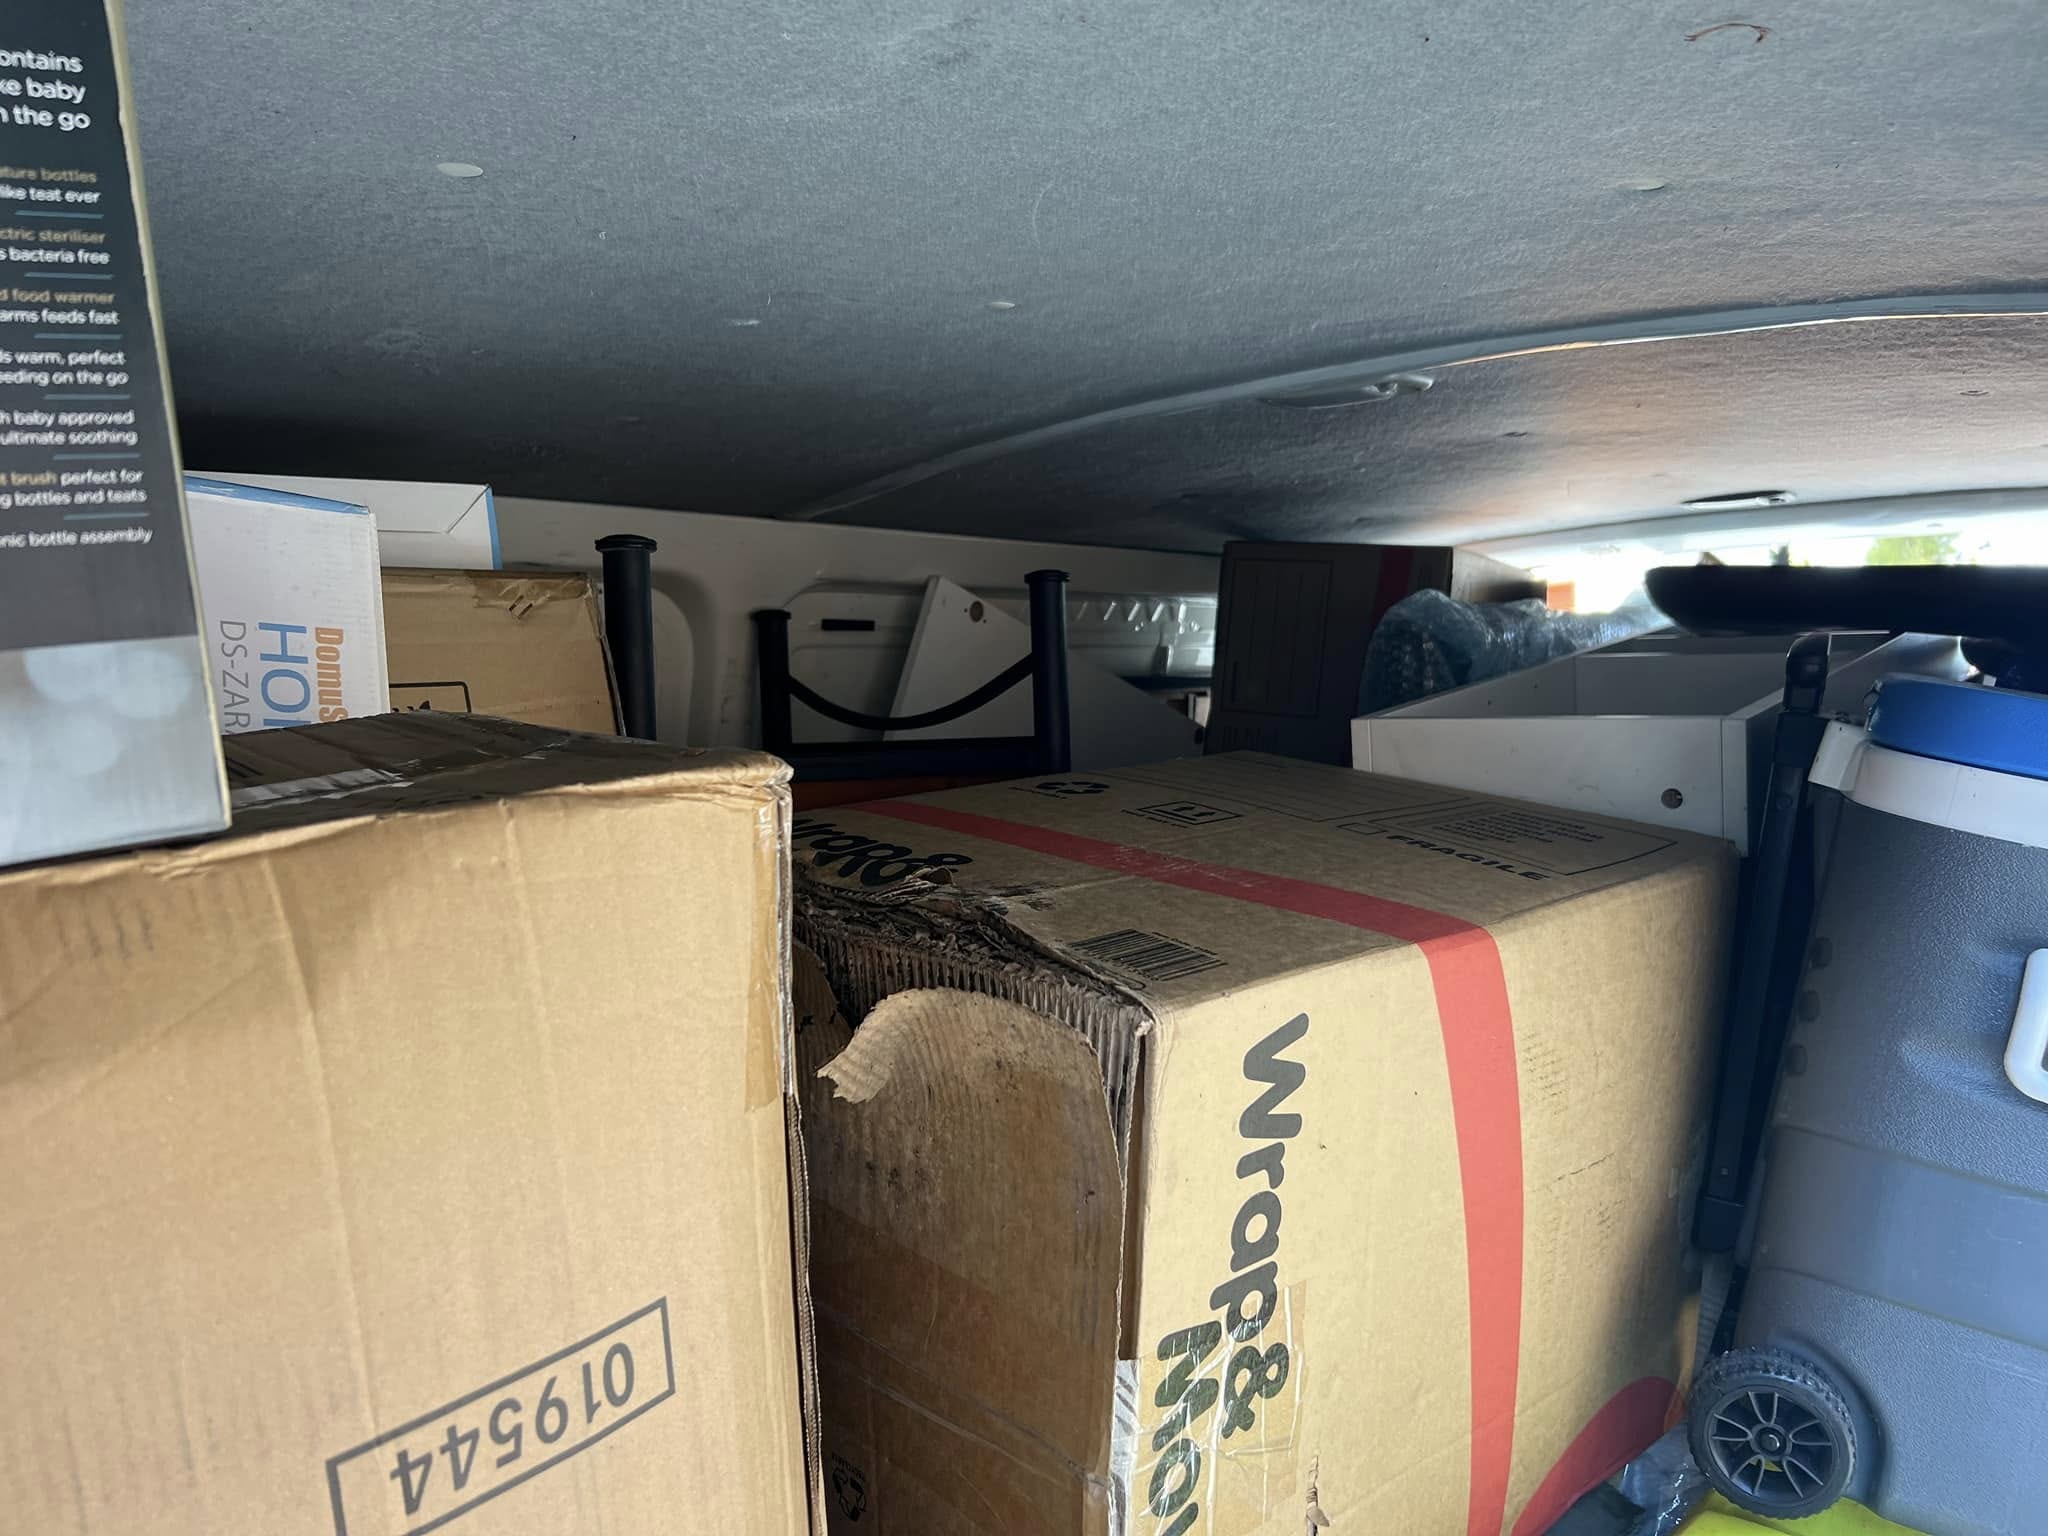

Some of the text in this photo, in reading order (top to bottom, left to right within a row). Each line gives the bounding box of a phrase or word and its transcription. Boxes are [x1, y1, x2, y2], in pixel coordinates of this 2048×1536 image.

[26, 76, 86, 104] baby
[13, 104, 55, 127] the
[58, 112, 91, 131] go
[29, 188, 63, 202] teat
[64, 190, 101, 204] ever
[8, 246, 75, 264] bacteria
[77, 249, 111, 265] free
[11, 289, 50, 303] food
[54, 292, 115, 304] warmer
[41, 308, 87, 325] feeds
[88, 309, 120, 325] fast
[67, 350, 127, 366] perfect
[51, 371, 75, 385] on
[76, 369, 104, 385] the
[105, 371, 129, 387] go
[13, 409, 55, 427] baby
[58, 408, 135, 426] approved
[68, 429, 138, 446] soothing
[10, 470, 59, 487] brush
[60, 469, 119, 487] perfect
[120, 468, 144, 484] for
[13, 490, 72, 506] bottles
[74, 488, 105, 505] and
[106, 488, 147, 504] teats
[28, 529, 79, 547] bottle
[80, 526, 153, 545] assembly
[220, 620, 251, 735] DS-ZAR
[1386, 834, 1551, 881] FRAGILE
[389, 1341, 635, 1516] 019544
